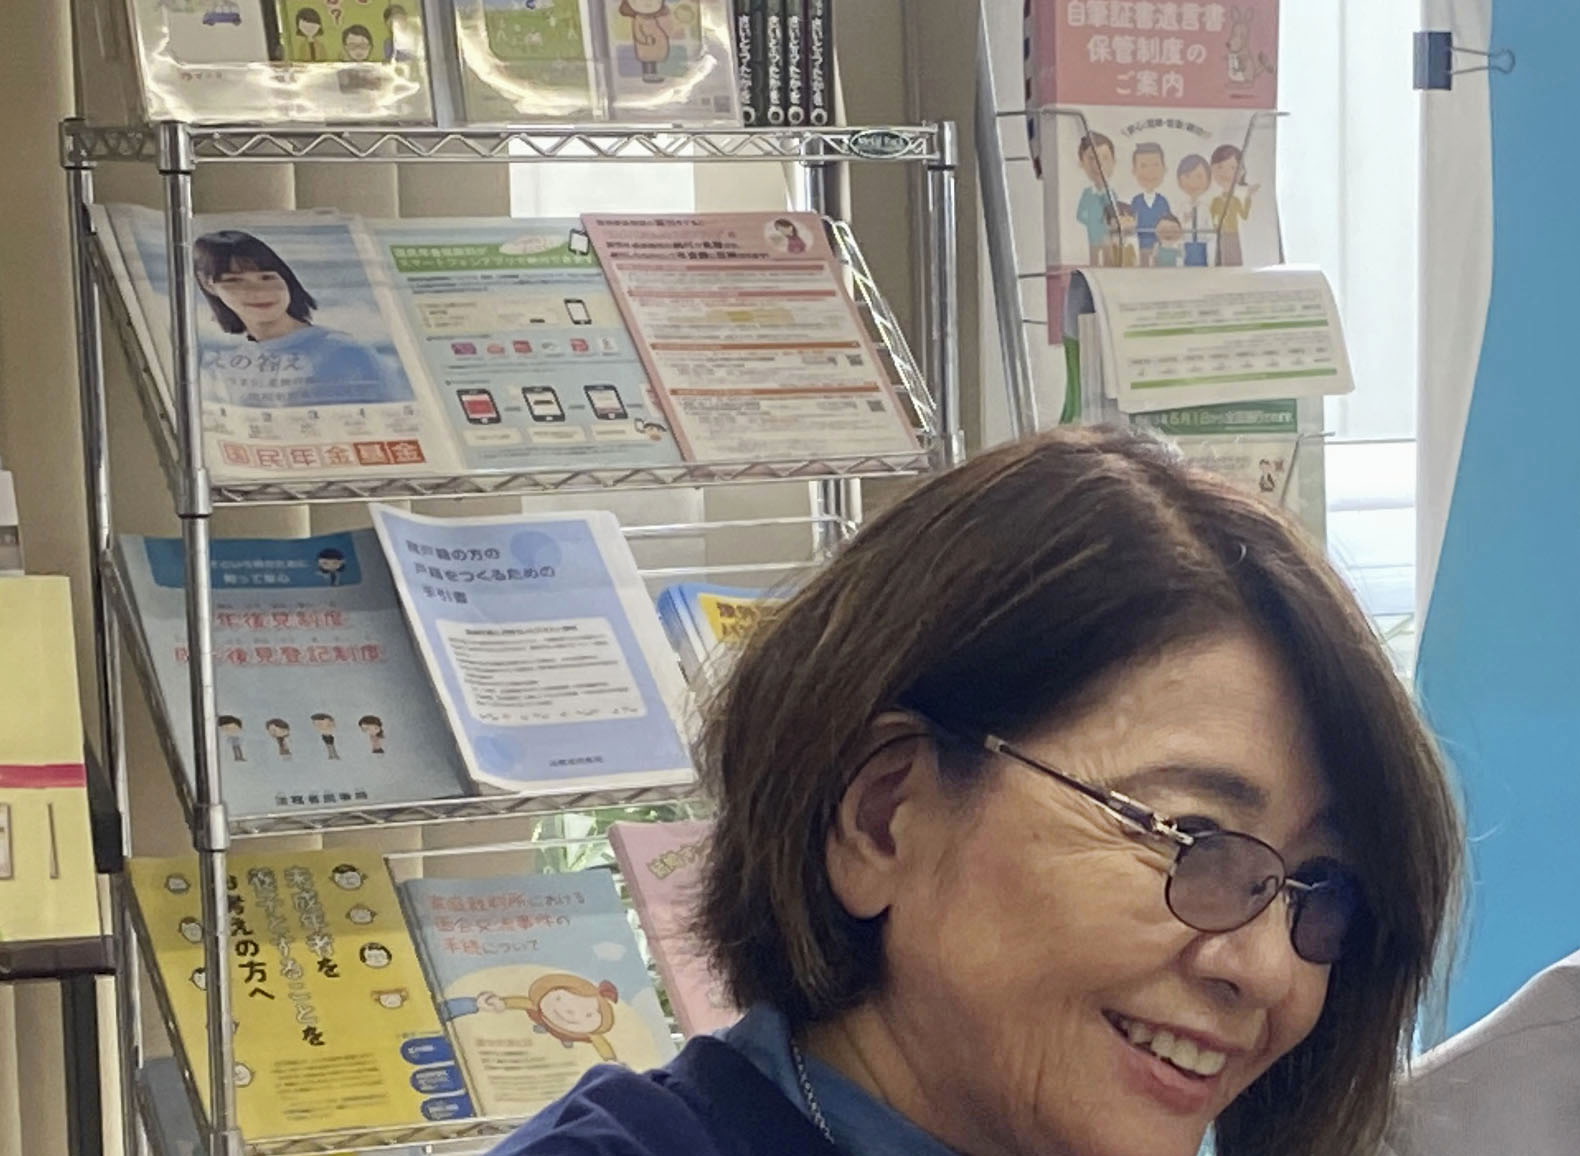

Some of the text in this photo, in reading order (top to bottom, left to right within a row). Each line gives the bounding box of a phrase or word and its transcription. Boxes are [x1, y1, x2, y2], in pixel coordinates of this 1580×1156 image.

[1087, 34, 1208, 65] 保管制度の
[1115, 70, 1184, 98] ご案内
[205, 351, 304, 373] えの答え
[221, 440, 421, 468] 国民年金基金
[414, 562, 556, 583] 戸籍をつくるための
[215, 610, 345, 629] 年後見制度
[174, 643, 383, 666] 後見登記制度
